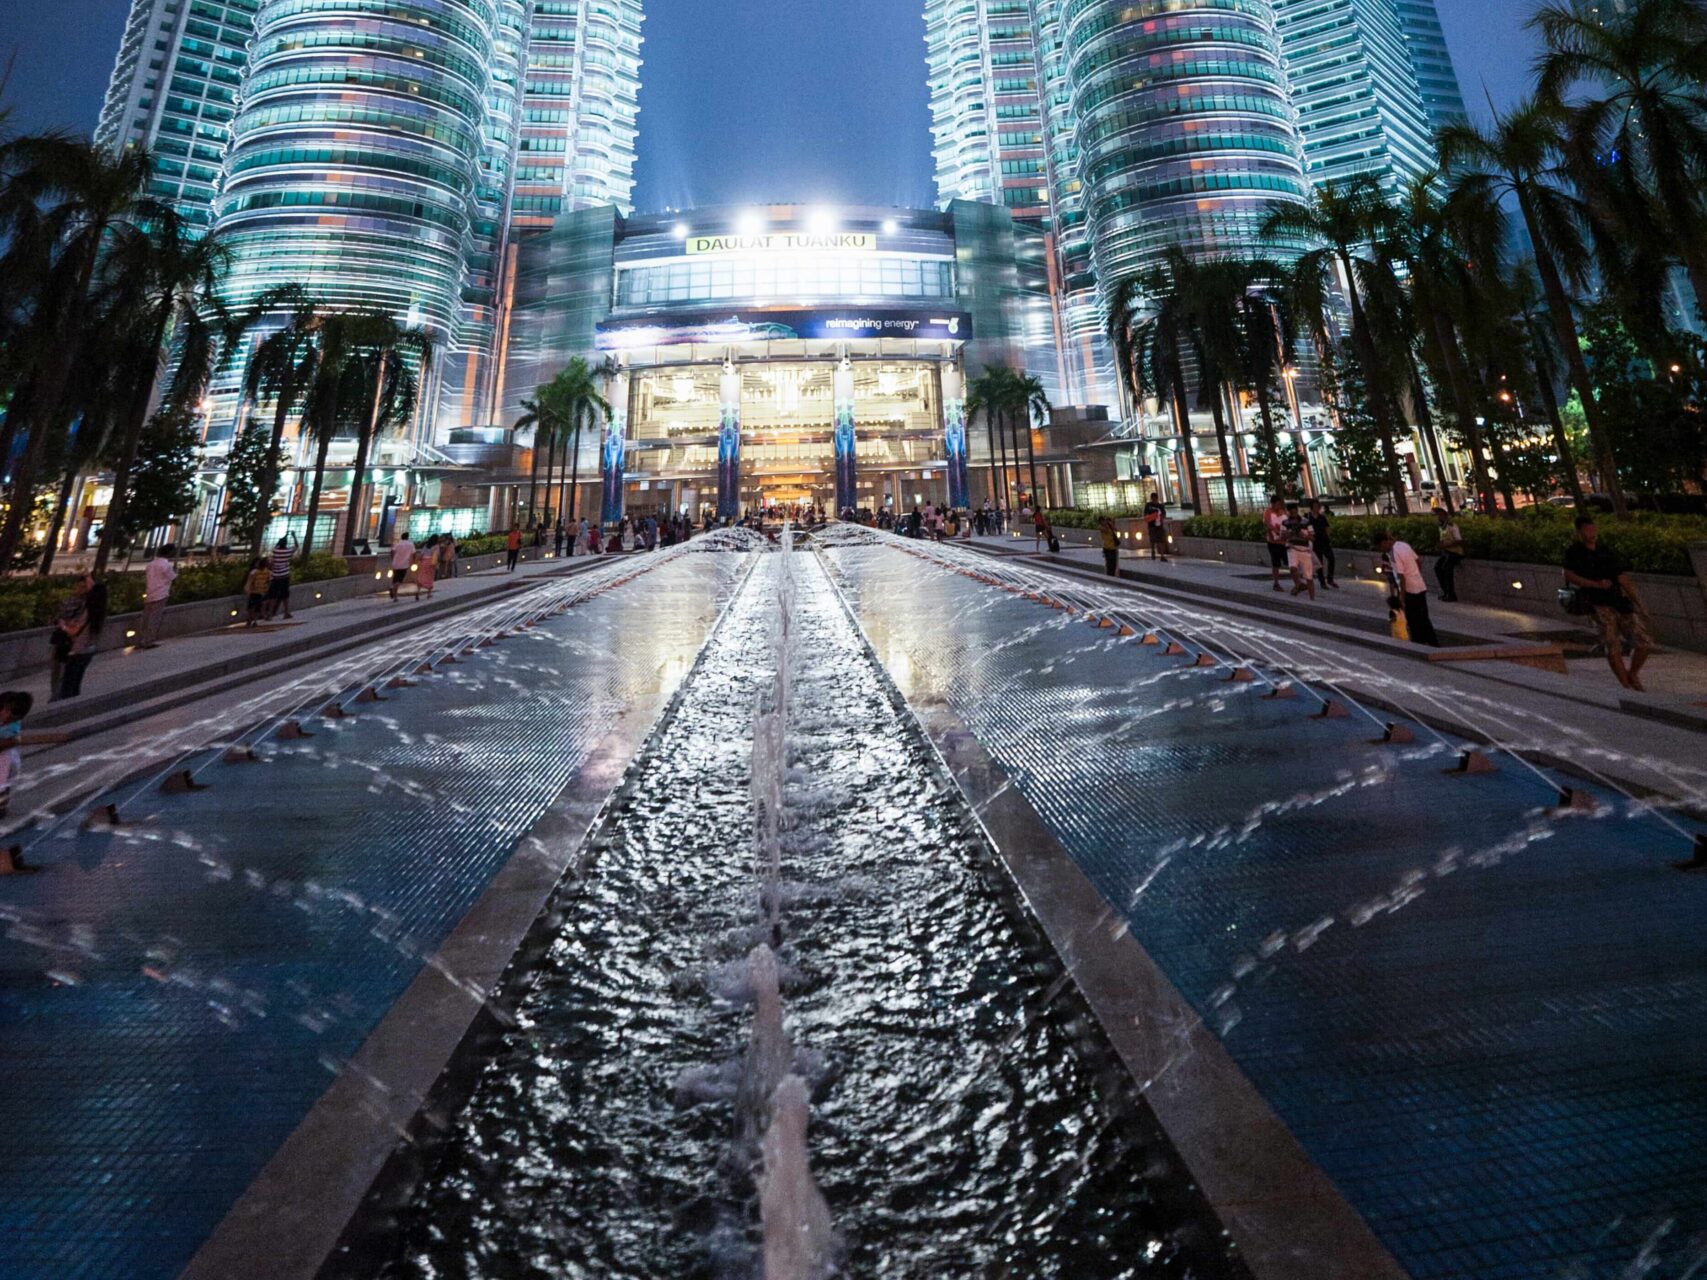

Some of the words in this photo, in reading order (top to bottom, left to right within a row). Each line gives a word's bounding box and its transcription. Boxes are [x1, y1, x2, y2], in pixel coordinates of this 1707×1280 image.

[696, 236, 773, 251] DAULAT
[784, 234, 866, 248] TUANKU
[826, 318, 882, 330] reimagining
